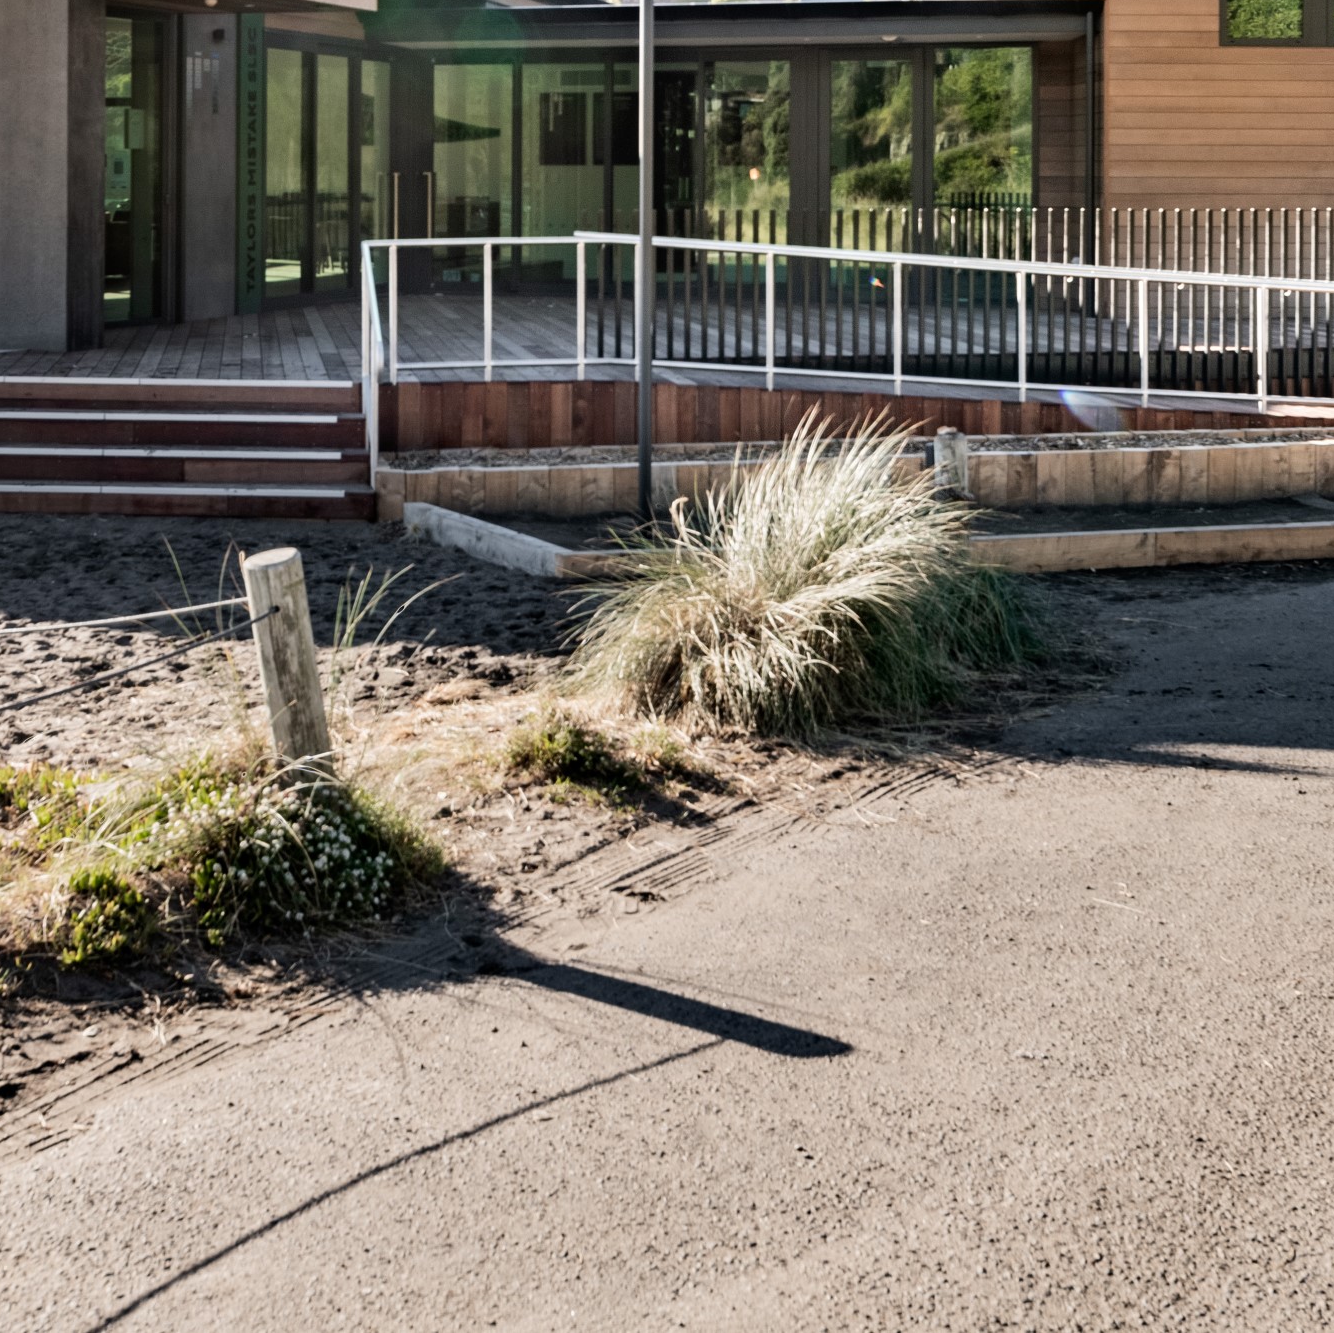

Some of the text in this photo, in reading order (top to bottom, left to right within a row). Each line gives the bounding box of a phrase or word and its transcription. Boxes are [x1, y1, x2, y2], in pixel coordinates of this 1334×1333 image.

[245, 26, 258, 294] TAYLORS MISTAKE SLSC
